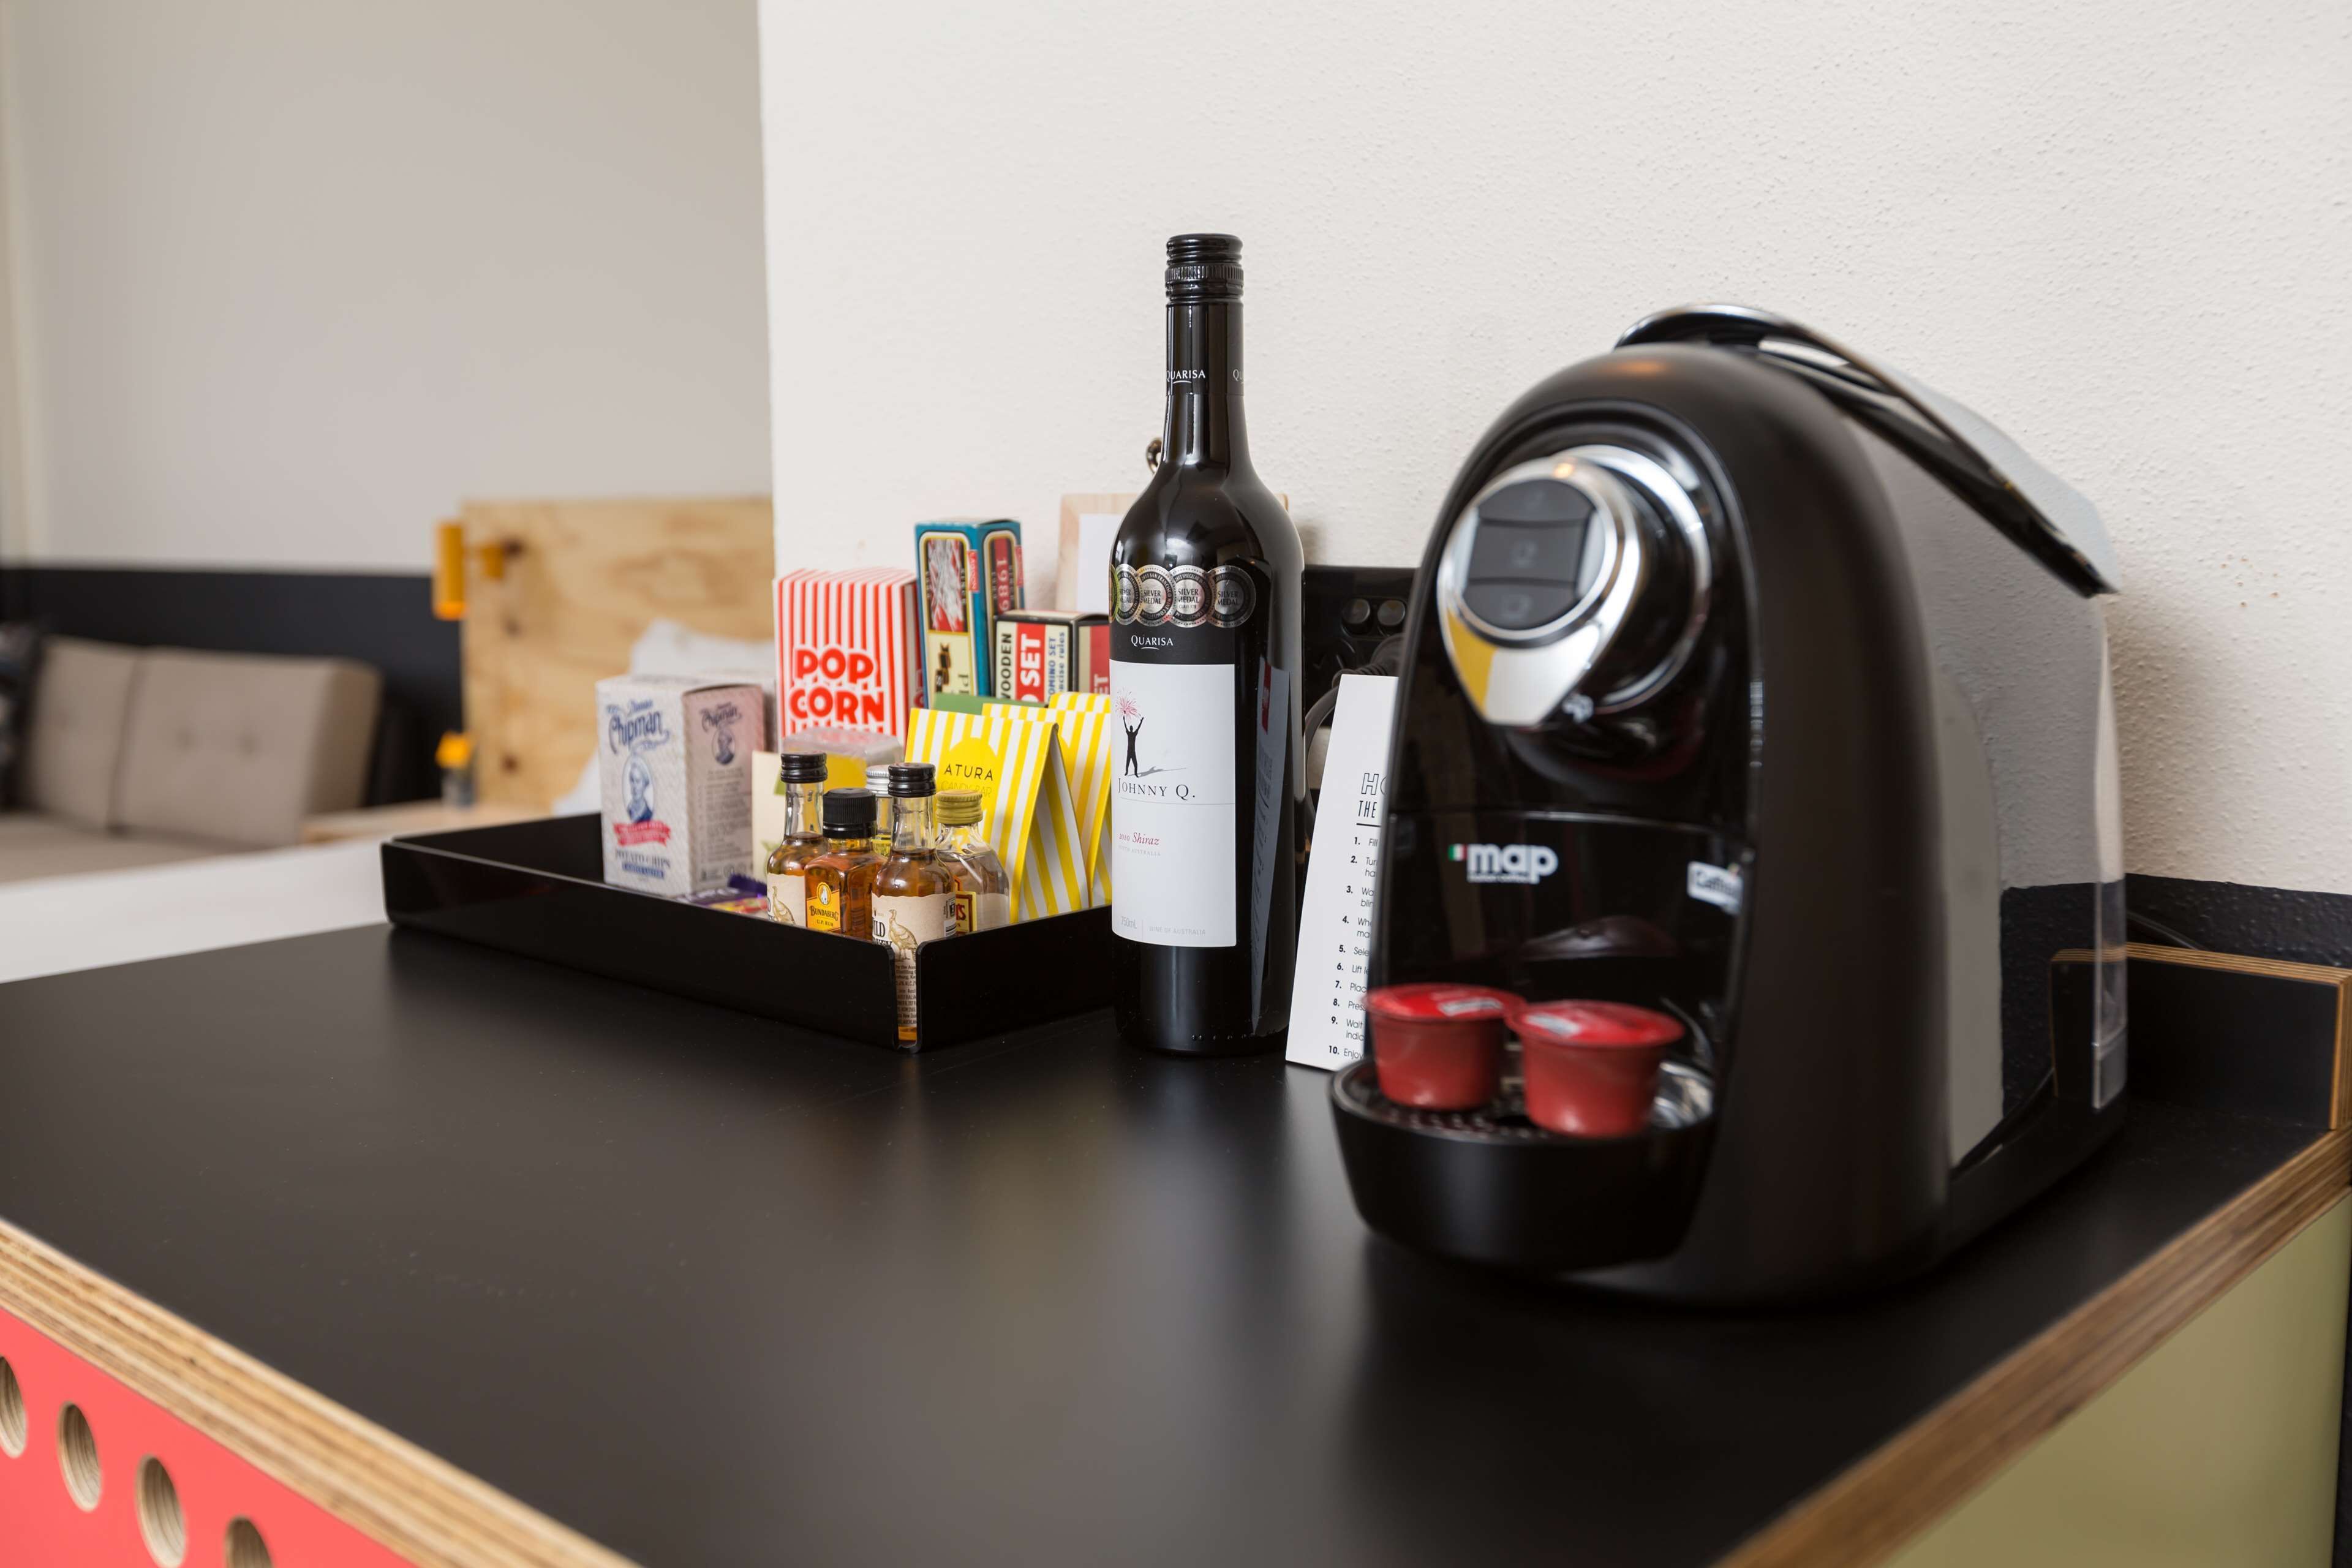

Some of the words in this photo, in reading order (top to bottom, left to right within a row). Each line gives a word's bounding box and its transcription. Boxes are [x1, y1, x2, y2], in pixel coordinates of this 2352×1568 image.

[1131, 635, 1174, 647] QUARISA
[796, 647, 874, 685] POP
[1001, 633, 1012, 699] OODEN
[1020, 633, 1041, 687] SET
[790, 686, 884, 725] CORN
[944, 763, 993, 782] ATURA
[1118, 778, 1167, 797] JOHNNY
[1175, 784, 1196, 801] Q.
[1358, 800, 1377, 818] THE
[1133, 832, 1160, 846] Shiraz
[1354, 837, 1360, 845] 1.
[1350, 855, 1357, 864] 2.
[1467, 843, 1559, 884] map
[1346, 885, 1353, 894] 3.
[809, 905, 839, 921] BUNDABERG
[1342, 916, 1349, 924] 4.
[1120, 916, 1137, 929] 750mL
[1172, 927, 1206, 937] AUSTRALIA
[1339, 944, 1346, 953] 5.
[1336, 962, 1344, 971] 6.
[1352, 965, 1363, 974] Lift
[1335, 980, 1342, 989] 7.
[1331, 1016, 1338, 1025] 9.
[1346, 1019, 1363, 1029] Wait
[1329, 1045, 1340, 1055] 10.
